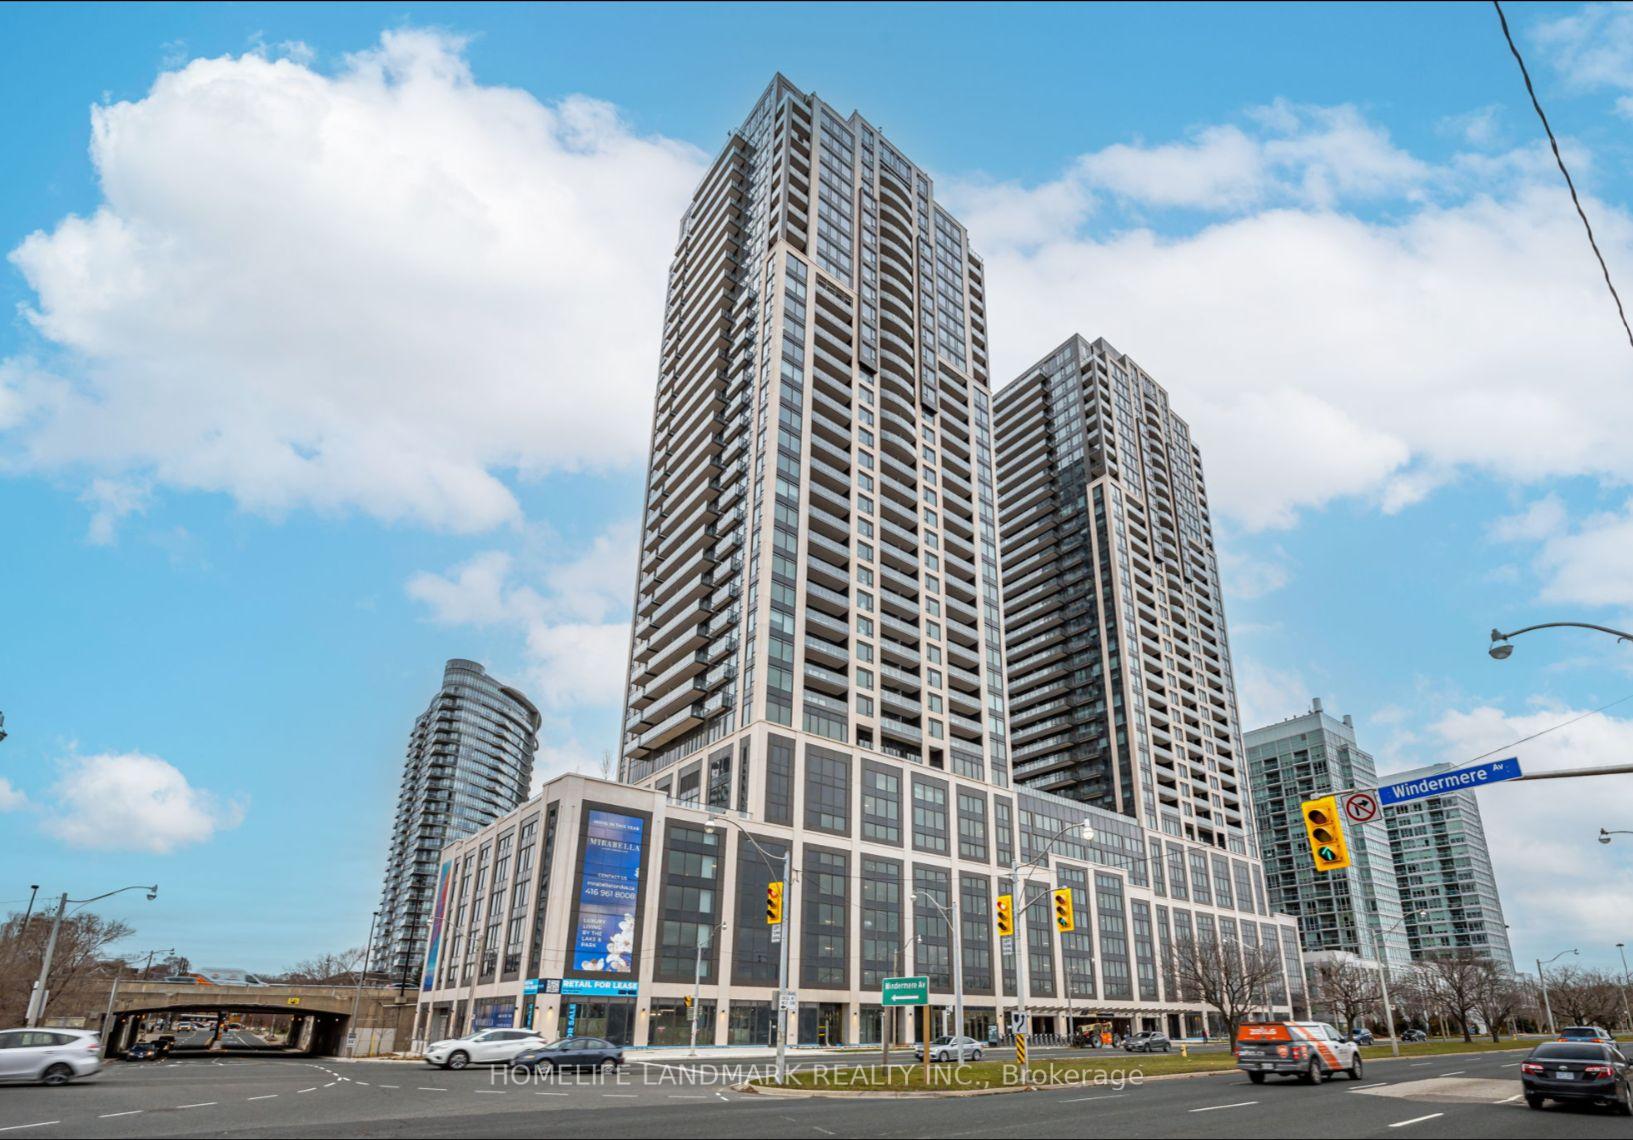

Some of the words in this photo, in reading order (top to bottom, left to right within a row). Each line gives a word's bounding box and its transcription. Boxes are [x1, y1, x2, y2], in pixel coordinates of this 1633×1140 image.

[1392, 768, 1488, 799] Windermere
[1492, 762, 1504, 772] Av
[590, 838, 640, 851] MIRABELLA
[585, 887, 599, 896] 416
[600, 889, 614, 898] 961
[563, 980, 592, 988] RETAIL
[594, 981, 611, 989] FOR
[613, 982, 638, 990] LEASE
[885, 982, 917, 990] Windermere
